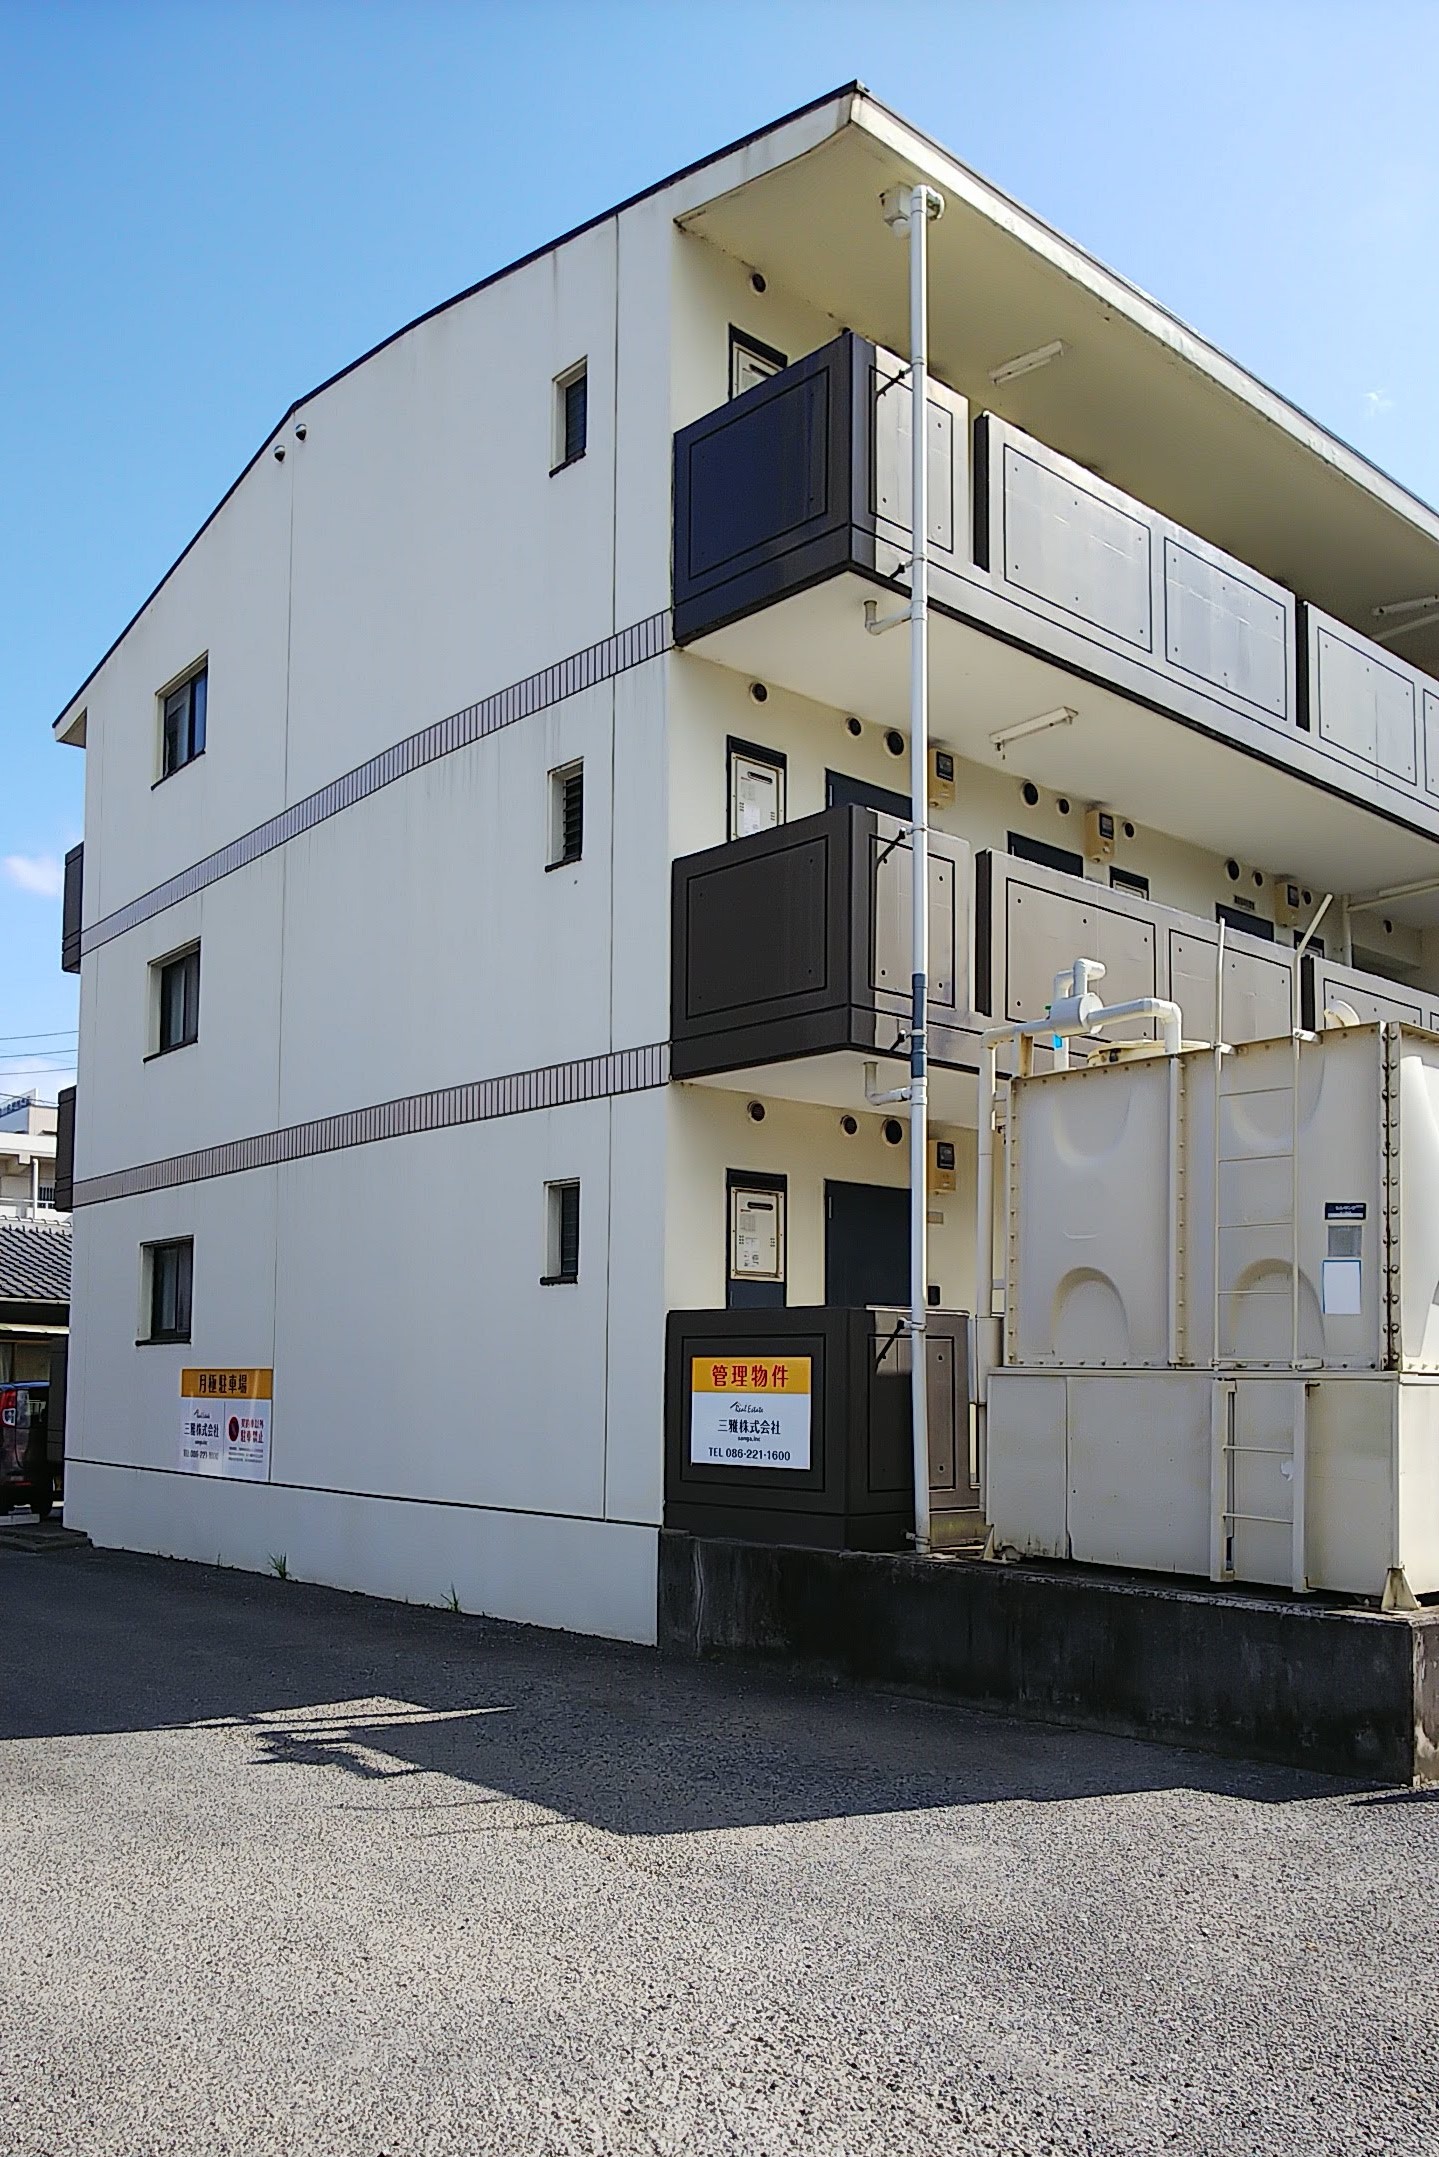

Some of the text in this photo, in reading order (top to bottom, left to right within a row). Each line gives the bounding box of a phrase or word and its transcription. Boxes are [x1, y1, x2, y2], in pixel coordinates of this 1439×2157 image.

[198, 1374, 248, 1394] 月極駐車場
[712, 1364, 789, 1388] 管理物件
[747, 1404, 764, 1414] Estate
[717, 1418, 781, 1435] 三雅株式会社
[708, 1447, 724, 1458] TEL
